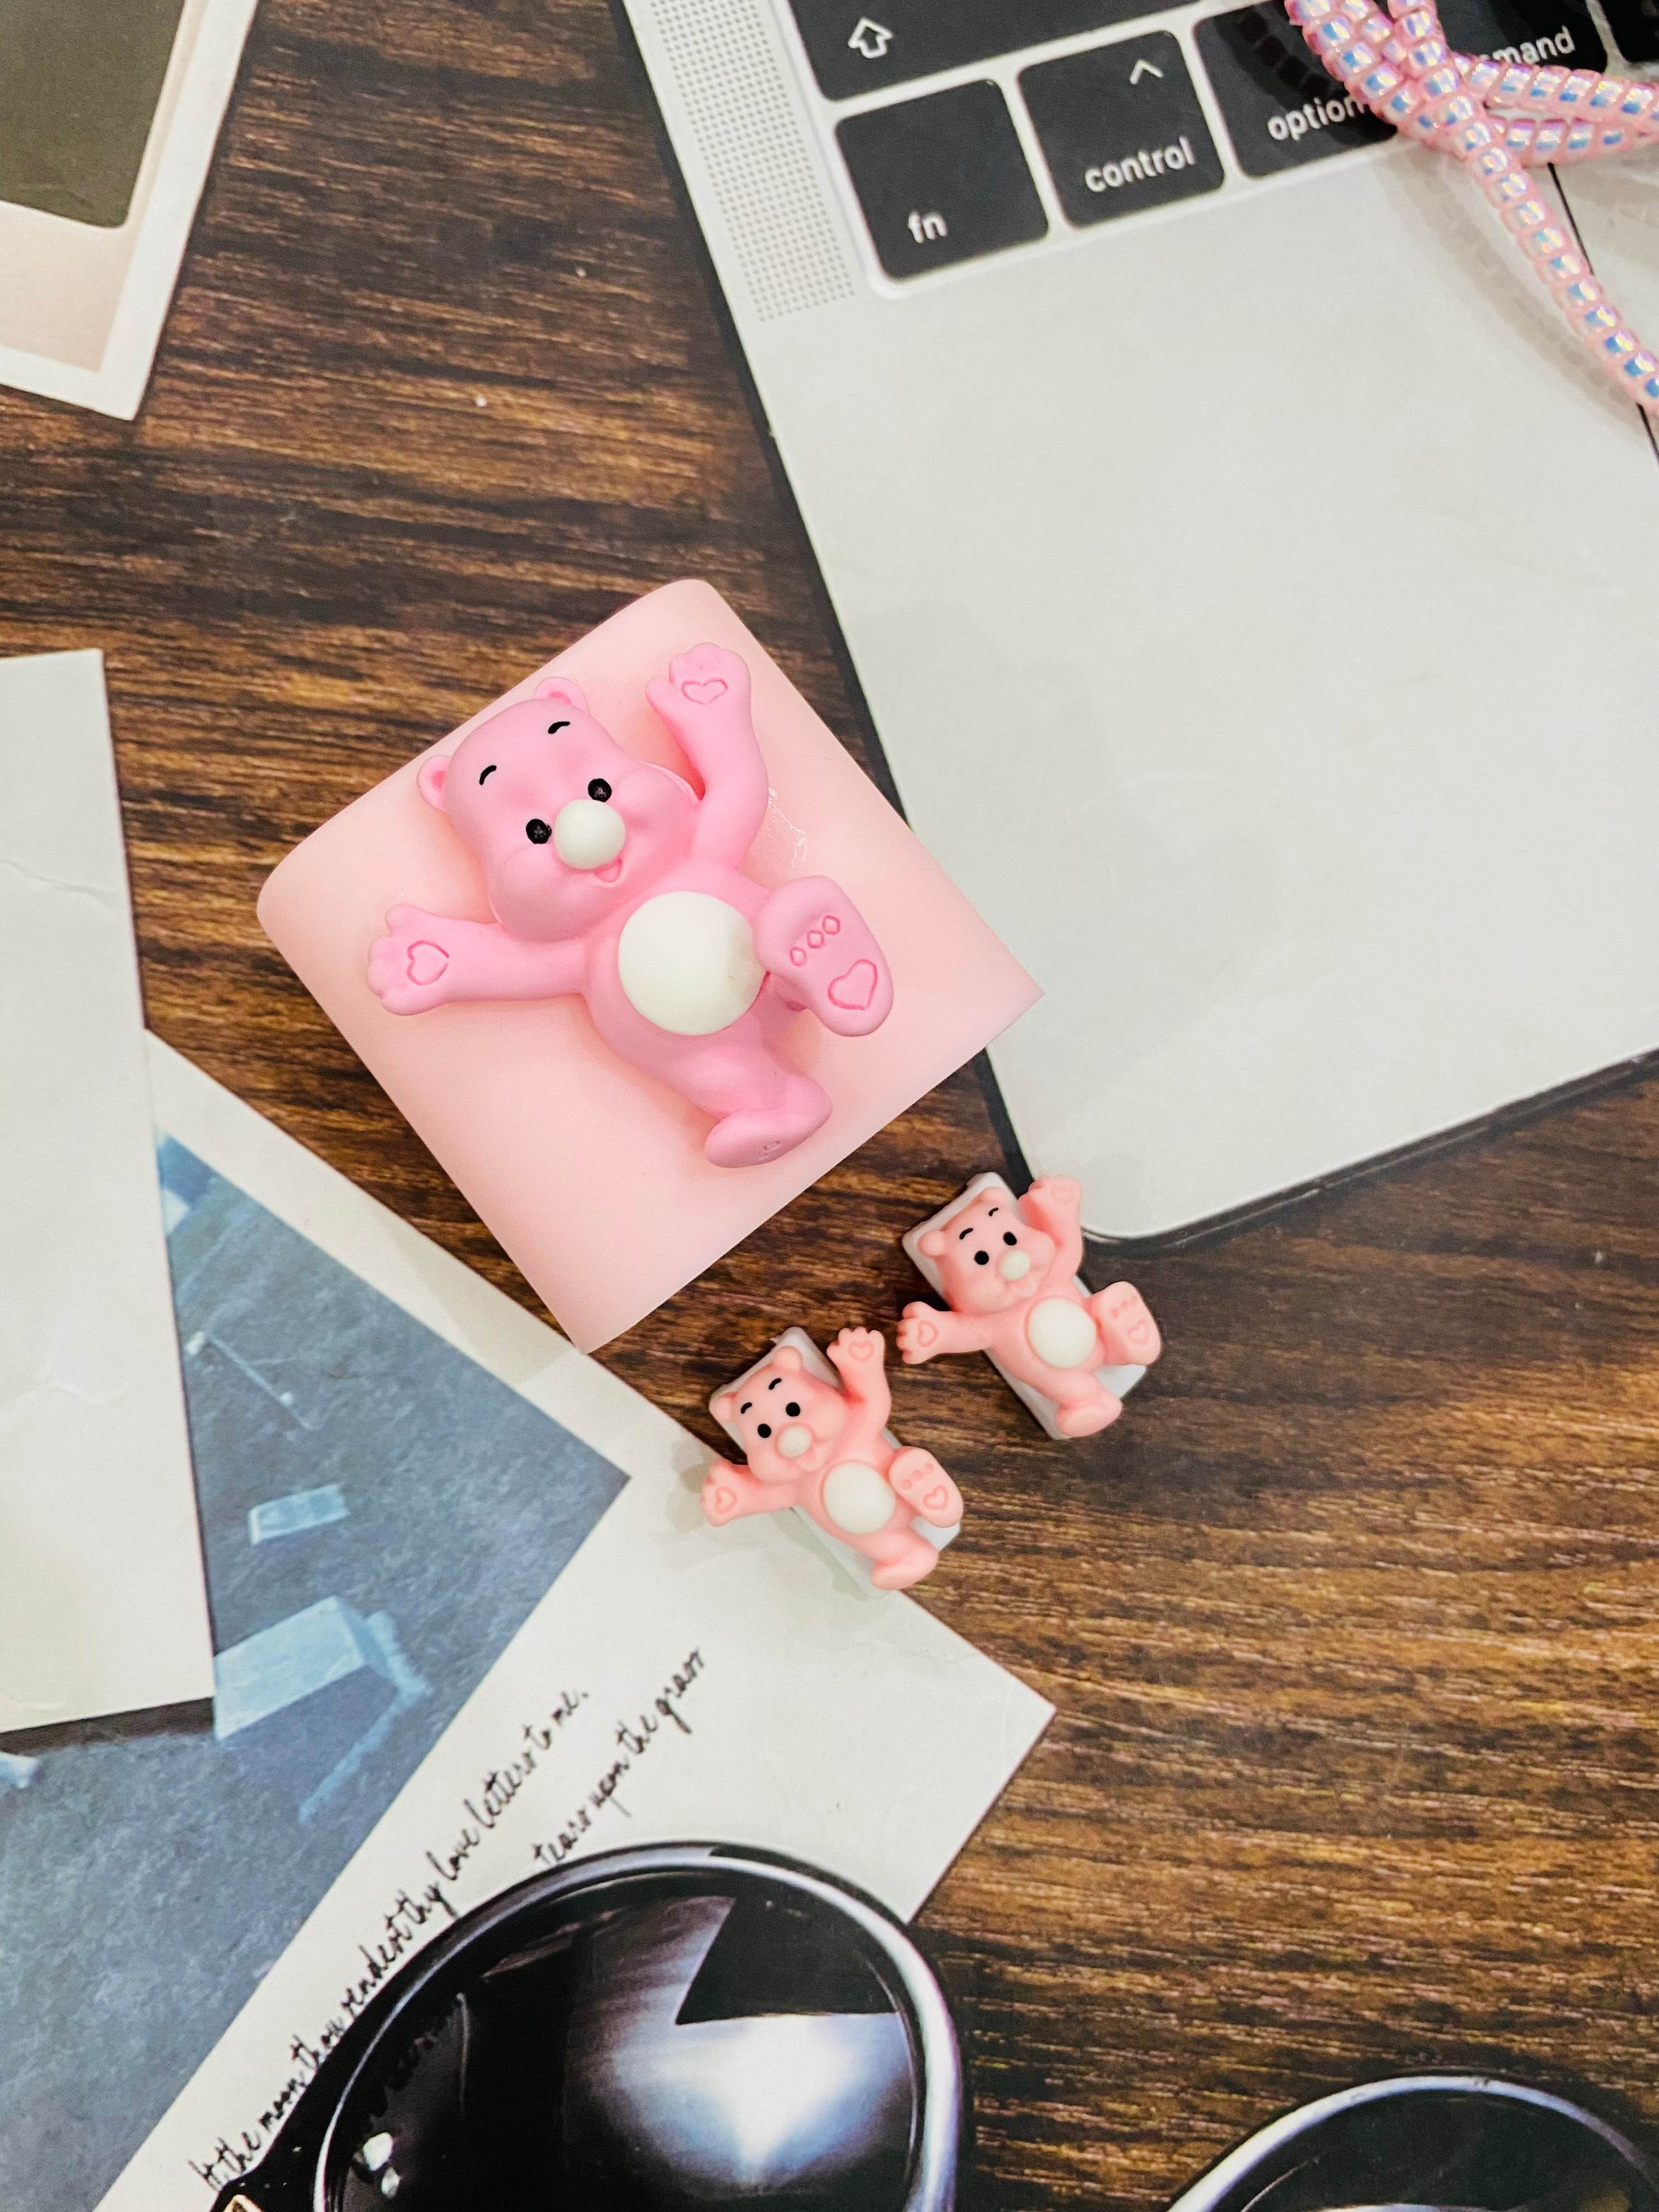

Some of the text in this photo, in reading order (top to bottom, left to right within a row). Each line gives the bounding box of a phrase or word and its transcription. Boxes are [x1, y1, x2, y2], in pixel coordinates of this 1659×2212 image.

[1480, 25, 1576, 65] mand
[1267, 96, 1365, 141] option
[1084, 136, 1197, 193] control
[907, 211, 948, 244] fn
[590, 1760, 631, 1818] upon
[616, 1714, 658, 1755] the
[425, 1829, 480, 1882] love
[523, 1725, 552, 1750] to
